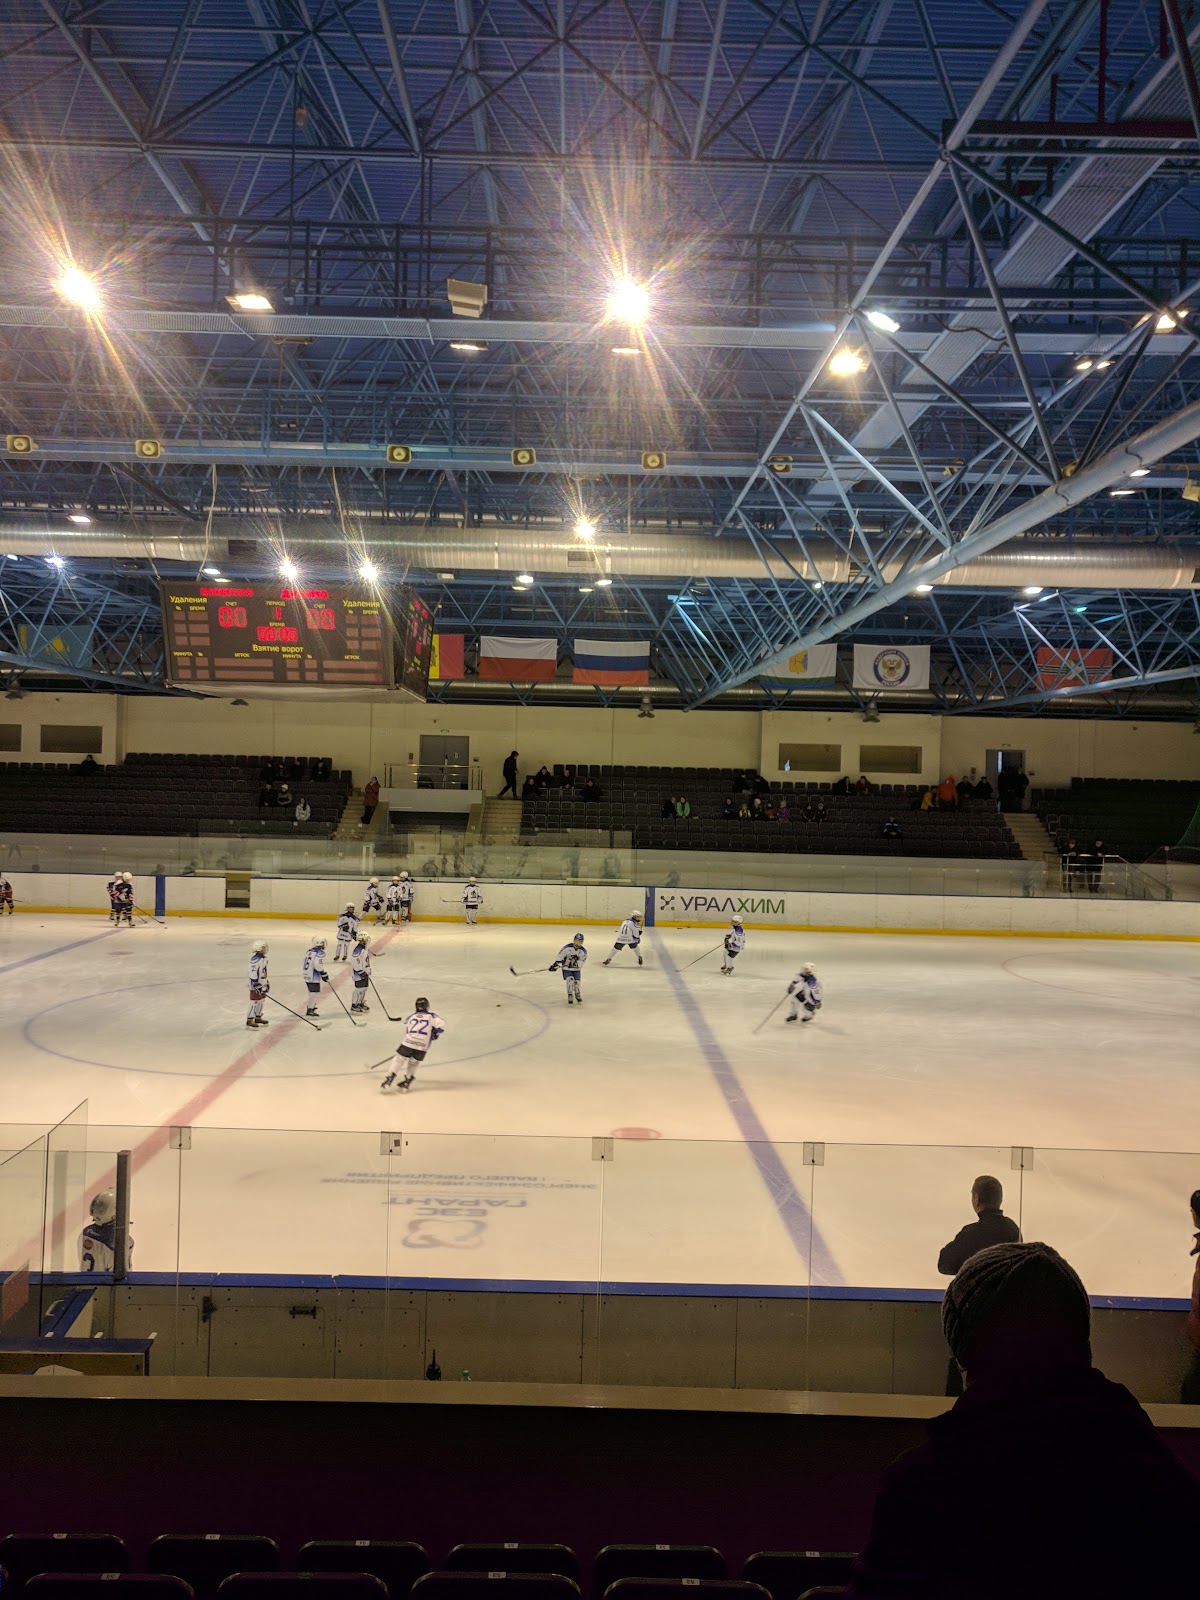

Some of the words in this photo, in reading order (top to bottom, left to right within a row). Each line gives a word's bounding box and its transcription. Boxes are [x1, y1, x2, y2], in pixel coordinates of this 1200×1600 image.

[343, 600, 380, 608] Удаления
[252, 644, 280, 652] Взятие
[680, 896, 785, 914] УРАЛХИМ
[409, 1018, 430, 1036] 22
[381, 1198, 527, 1208] ГАРАНТ
